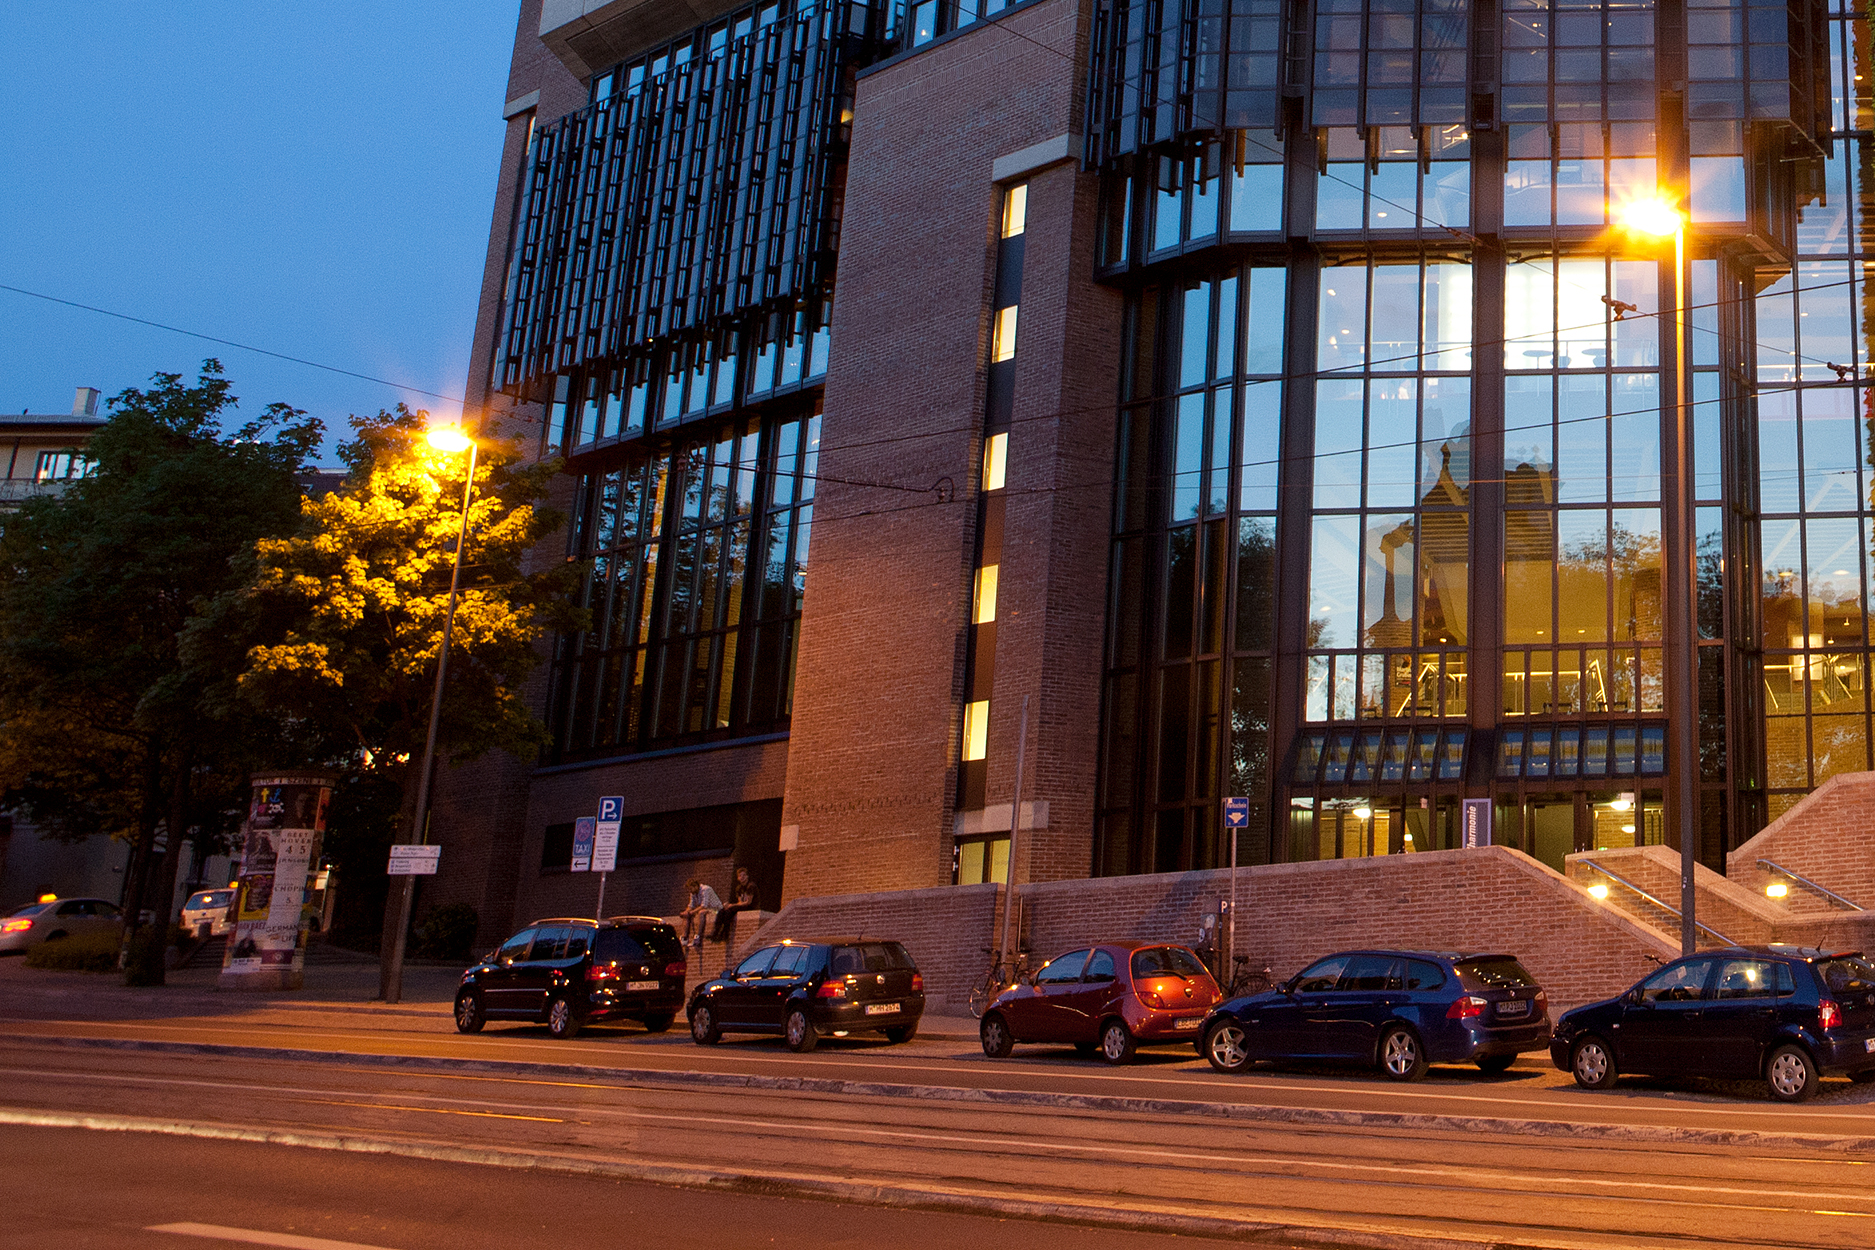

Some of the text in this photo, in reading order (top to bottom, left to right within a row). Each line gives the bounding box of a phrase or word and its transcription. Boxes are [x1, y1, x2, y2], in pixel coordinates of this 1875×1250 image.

[601, 799, 616, 820] P
[285, 845, 306, 854] 4 5
[575, 843, 590, 853] TAXI
[1221, 900, 1228, 913] P
